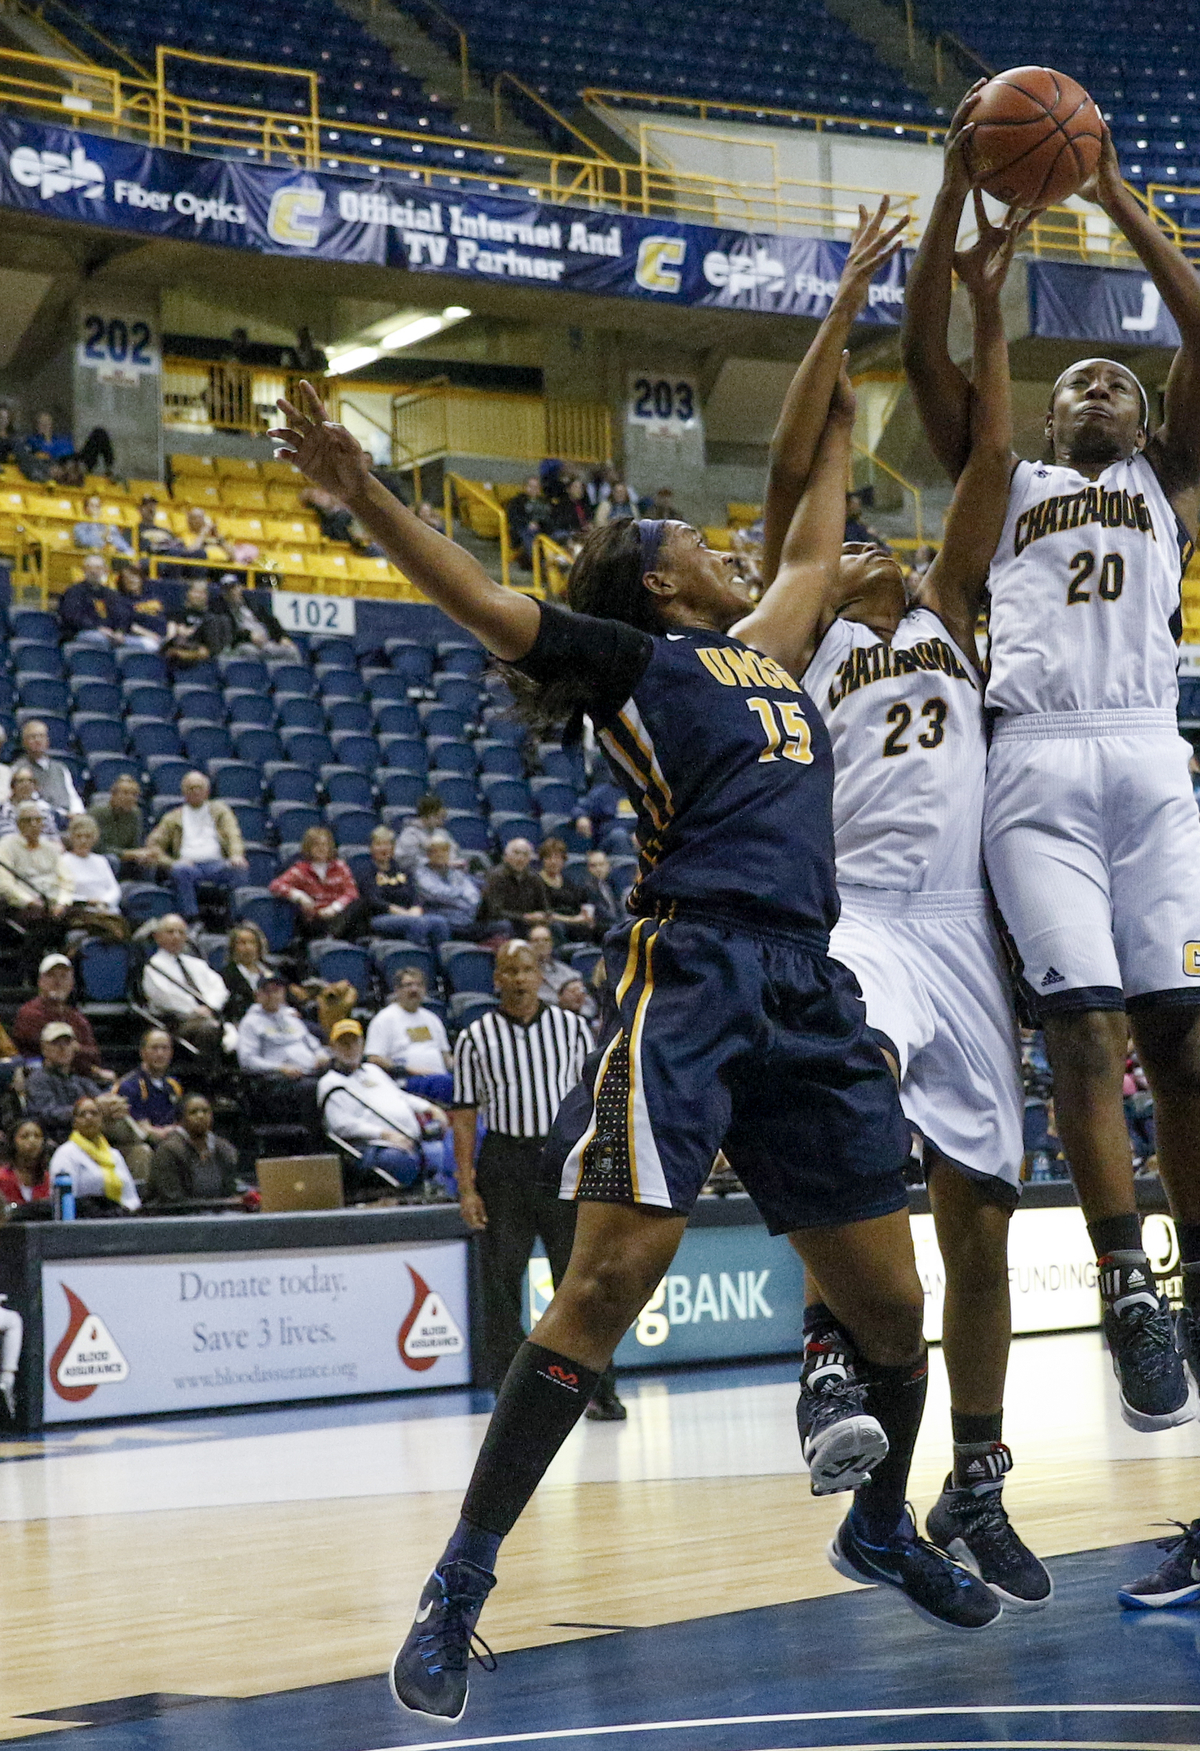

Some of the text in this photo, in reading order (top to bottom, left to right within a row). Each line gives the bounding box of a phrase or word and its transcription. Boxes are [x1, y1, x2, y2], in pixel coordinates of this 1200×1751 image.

[9, 146, 248, 226] epb Fiber Optics
[267, 183, 326, 248] C
[339, 191, 622, 257] Official Internet And
[402, 231, 564, 282] TV Partner
[635, 236, 687, 294] C
[703, 249, 786, 295] epb
[868, 283, 905, 307] ptic
[85, 315, 151, 365] 202
[634, 378, 694, 420] 203
[1067, 550, 1125, 606] 20
[290, 600, 338, 628] 102
[745, 697, 814, 765] 15
[883, 698, 949, 758] 23
[179, 1264, 348, 1303] Donate today.
[192, 1316, 336, 1354] Save 3 lives.
[173, 1361, 358, 1390] www.bloodassurance.org
